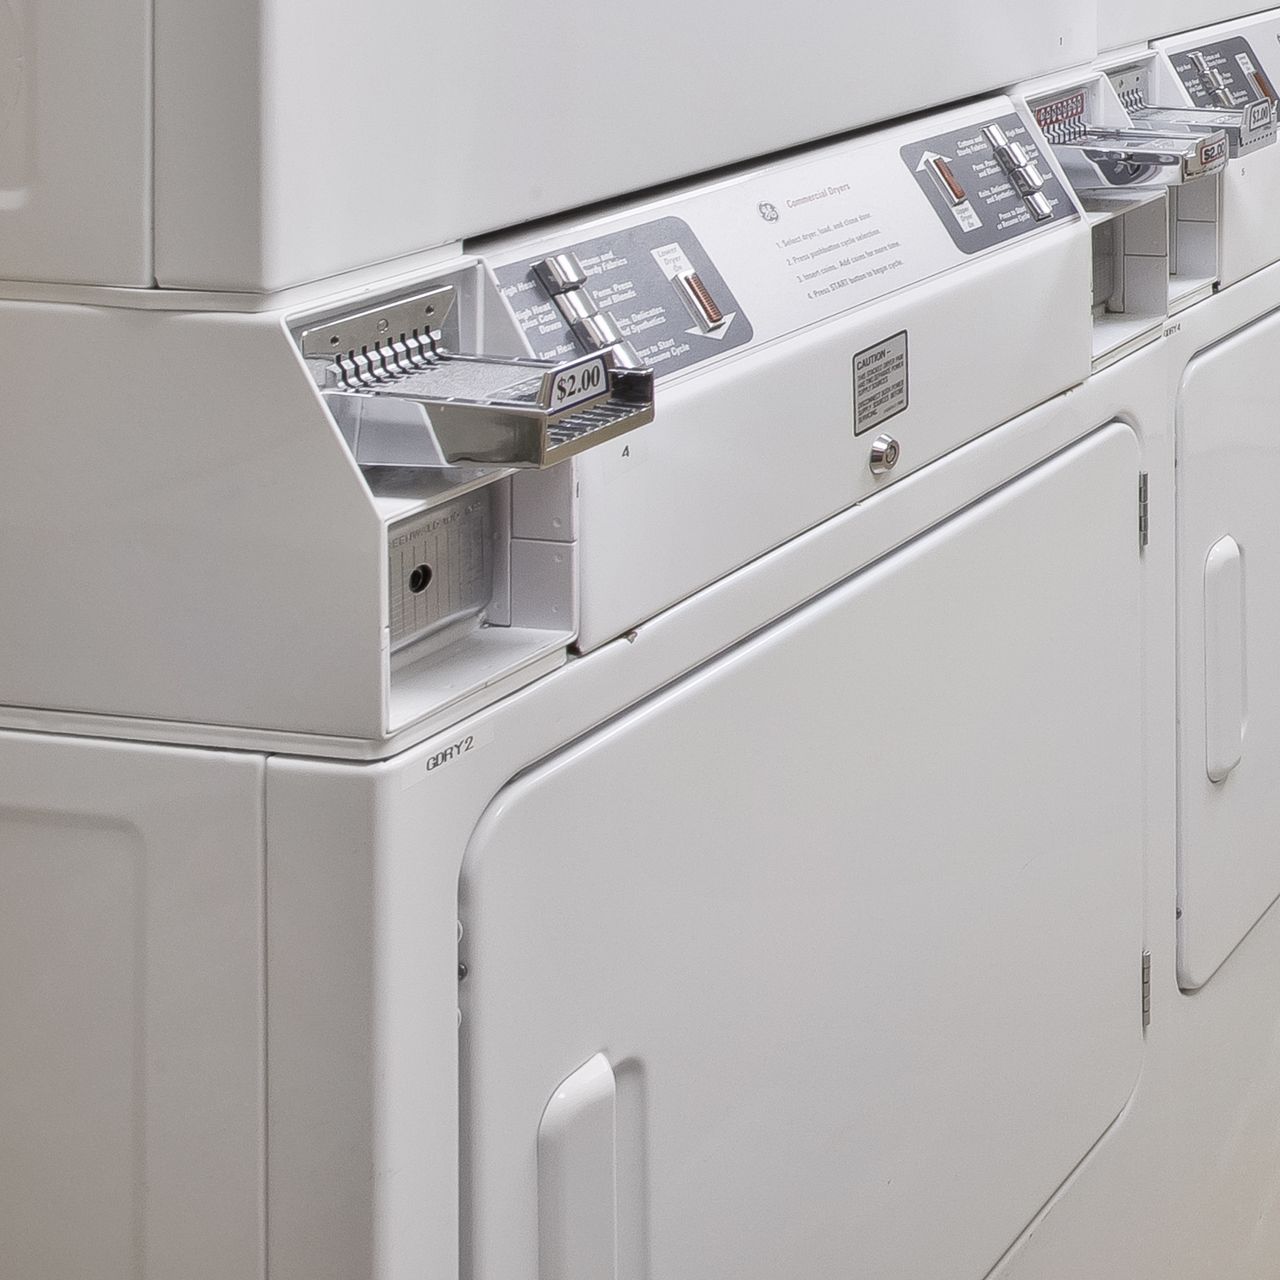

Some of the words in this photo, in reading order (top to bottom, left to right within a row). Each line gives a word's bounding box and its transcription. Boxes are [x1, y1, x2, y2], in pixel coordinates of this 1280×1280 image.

[1252, 106, 1269, 124] $2.00
[786, 189, 828, 208] Commercial
[827, 184, 850, 195] Dryers
[538, 321, 562, 334] Down
[539, 349, 556, 360] Low
[556, 341, 576, 355] Heat
[657, 338, 675, 350] Start
[670, 343, 690, 356] Cycle
[857, 349, 885, 371] CAUTION
[557, 365, 600, 403] $2.00
[426, 735, 474, 771] GDRY2
